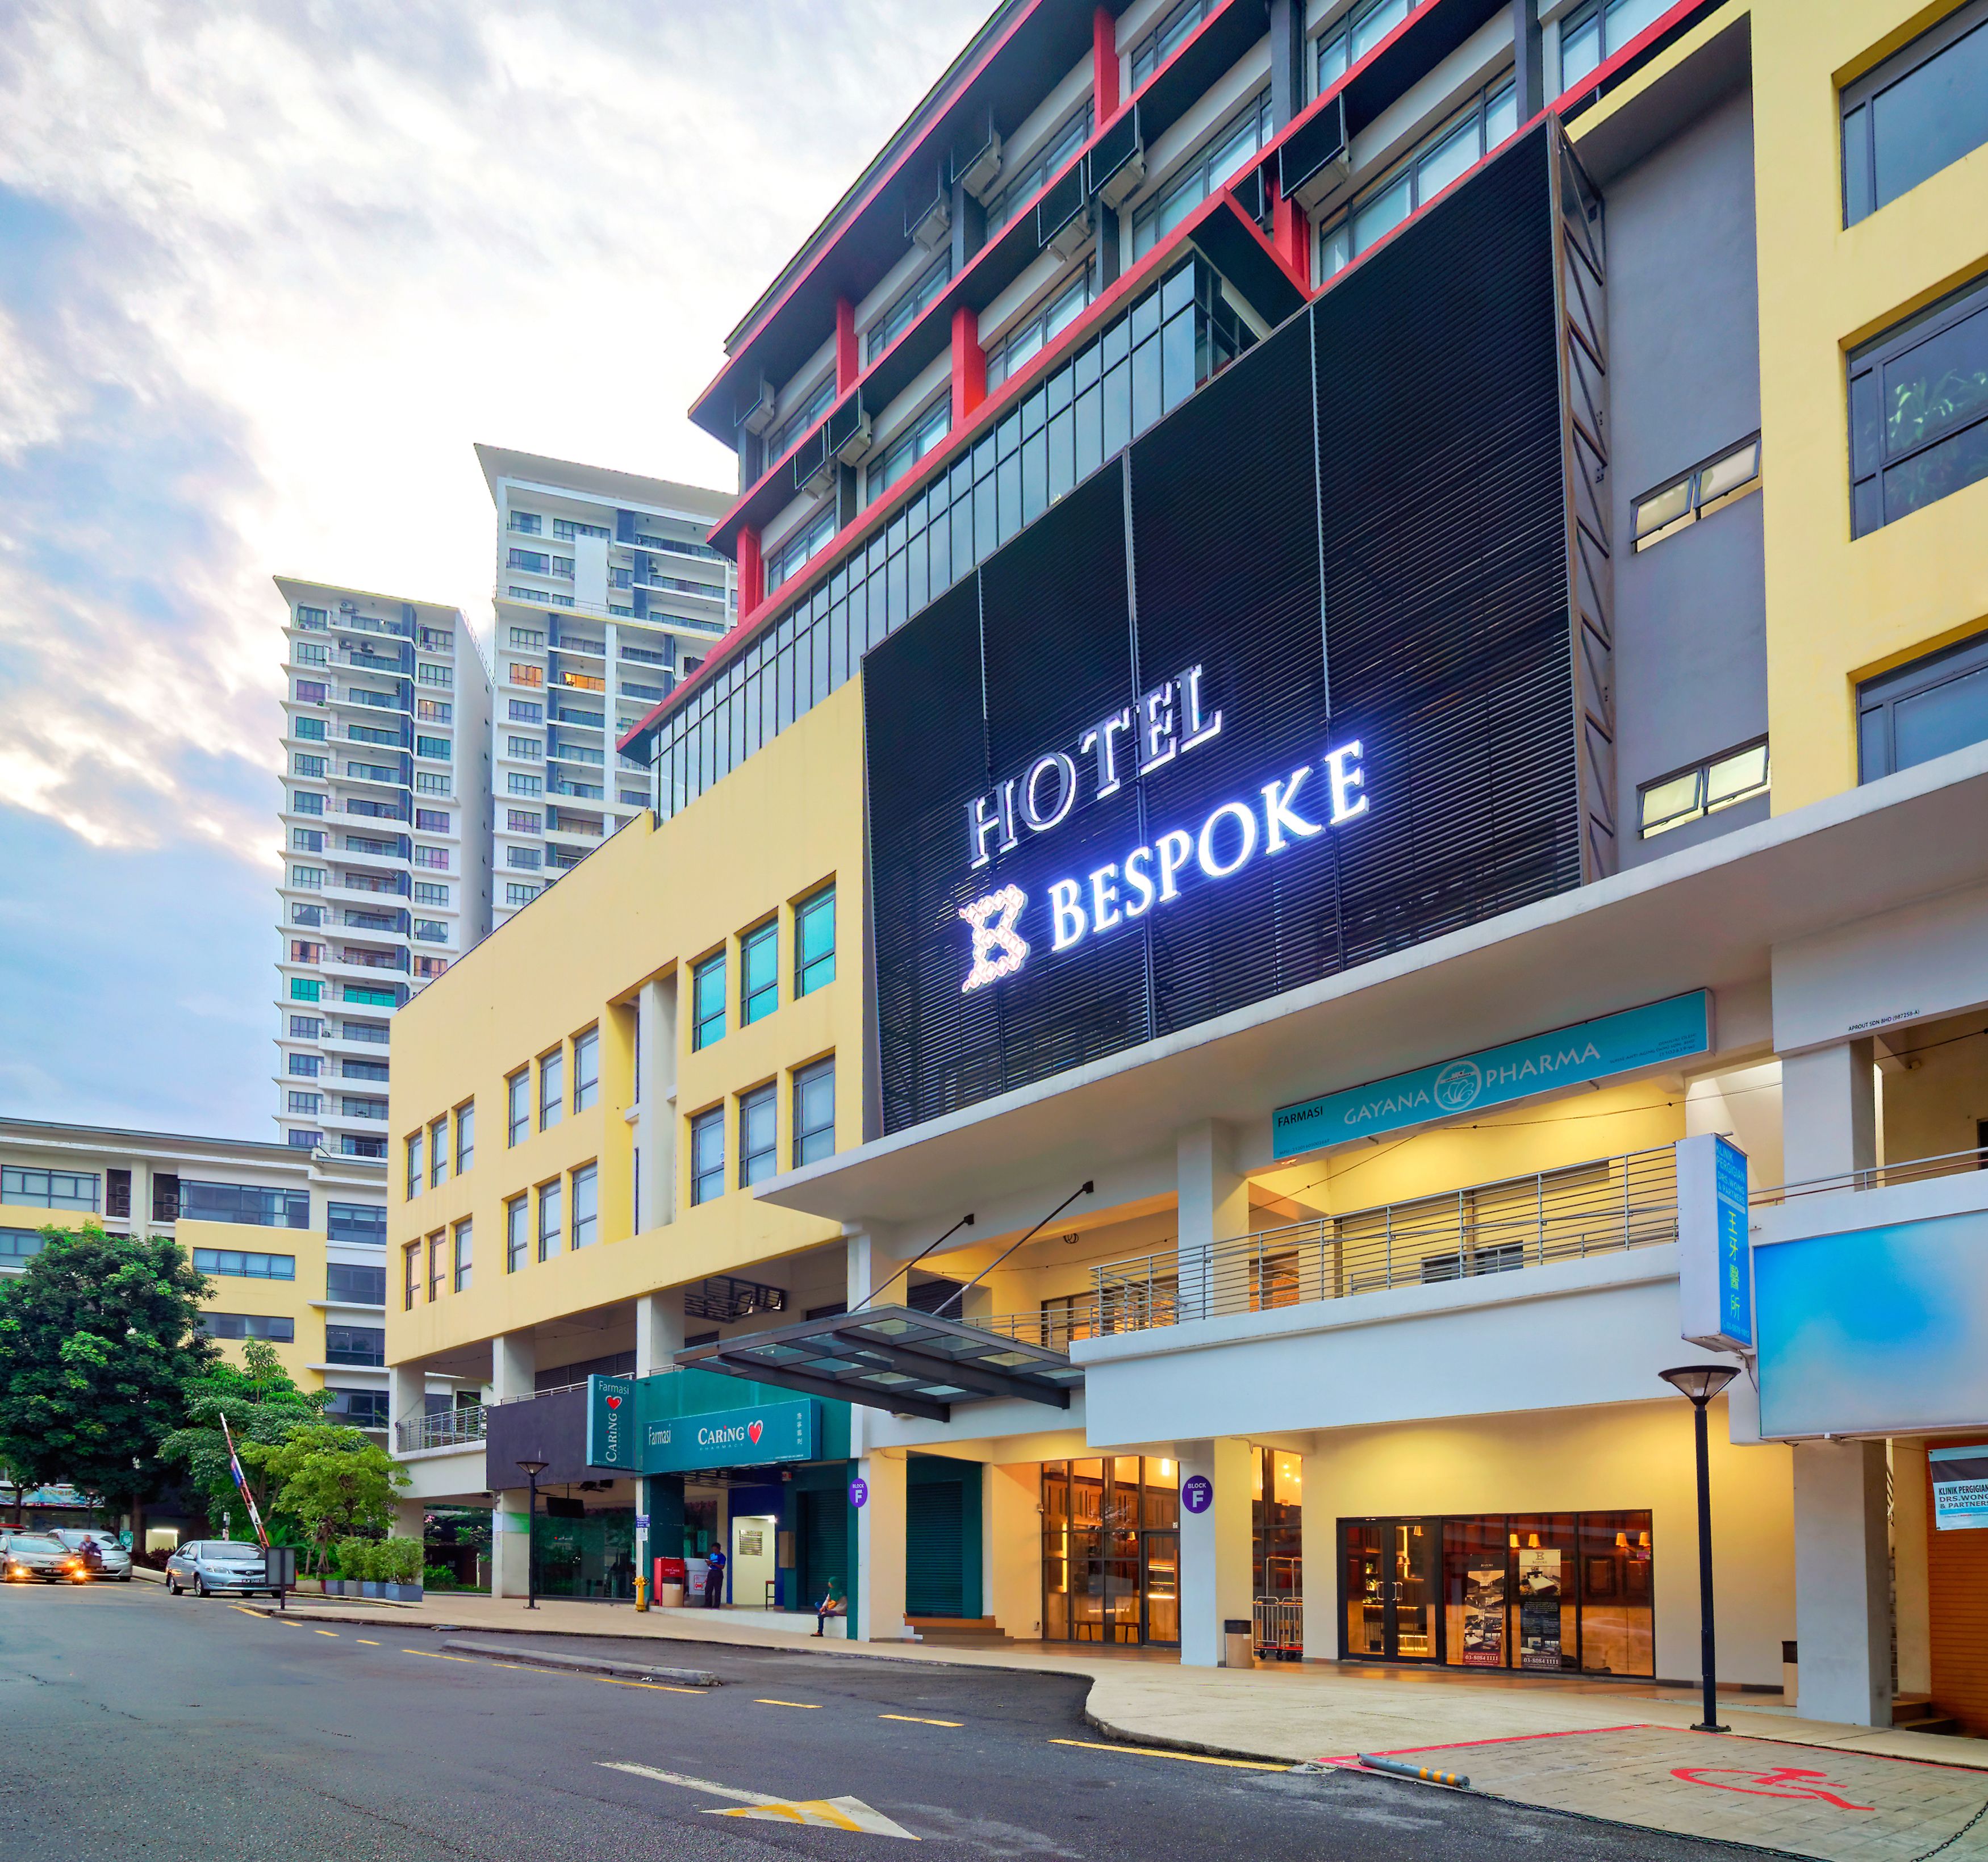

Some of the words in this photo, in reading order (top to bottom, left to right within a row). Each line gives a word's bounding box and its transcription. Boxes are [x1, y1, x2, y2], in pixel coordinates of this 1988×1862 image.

[963, 663, 1222, 870] HOTEL
[1046, 738, 1369, 951] BESPOKE
[1344, 1089, 1430, 1125] GAYANA
[1486, 1042, 1601, 1088] PHARMA
[1278, 1105, 1323, 1127] FARMASI
[1715, 1141, 1734, 1164] KLINIK
[1716, 1155, 1745, 1183] PERGIGIAN
[599, 1380, 629, 1395] Farmasi
[649, 1423, 671, 1446] Farmasi
[855, 1489, 863, 1504] F
[1193, 1490, 1204, 1508] F
[1939, 1486, 1957, 1495] KLINIK
[1958, 1484, 1988, 1494] PERGIGIAN
